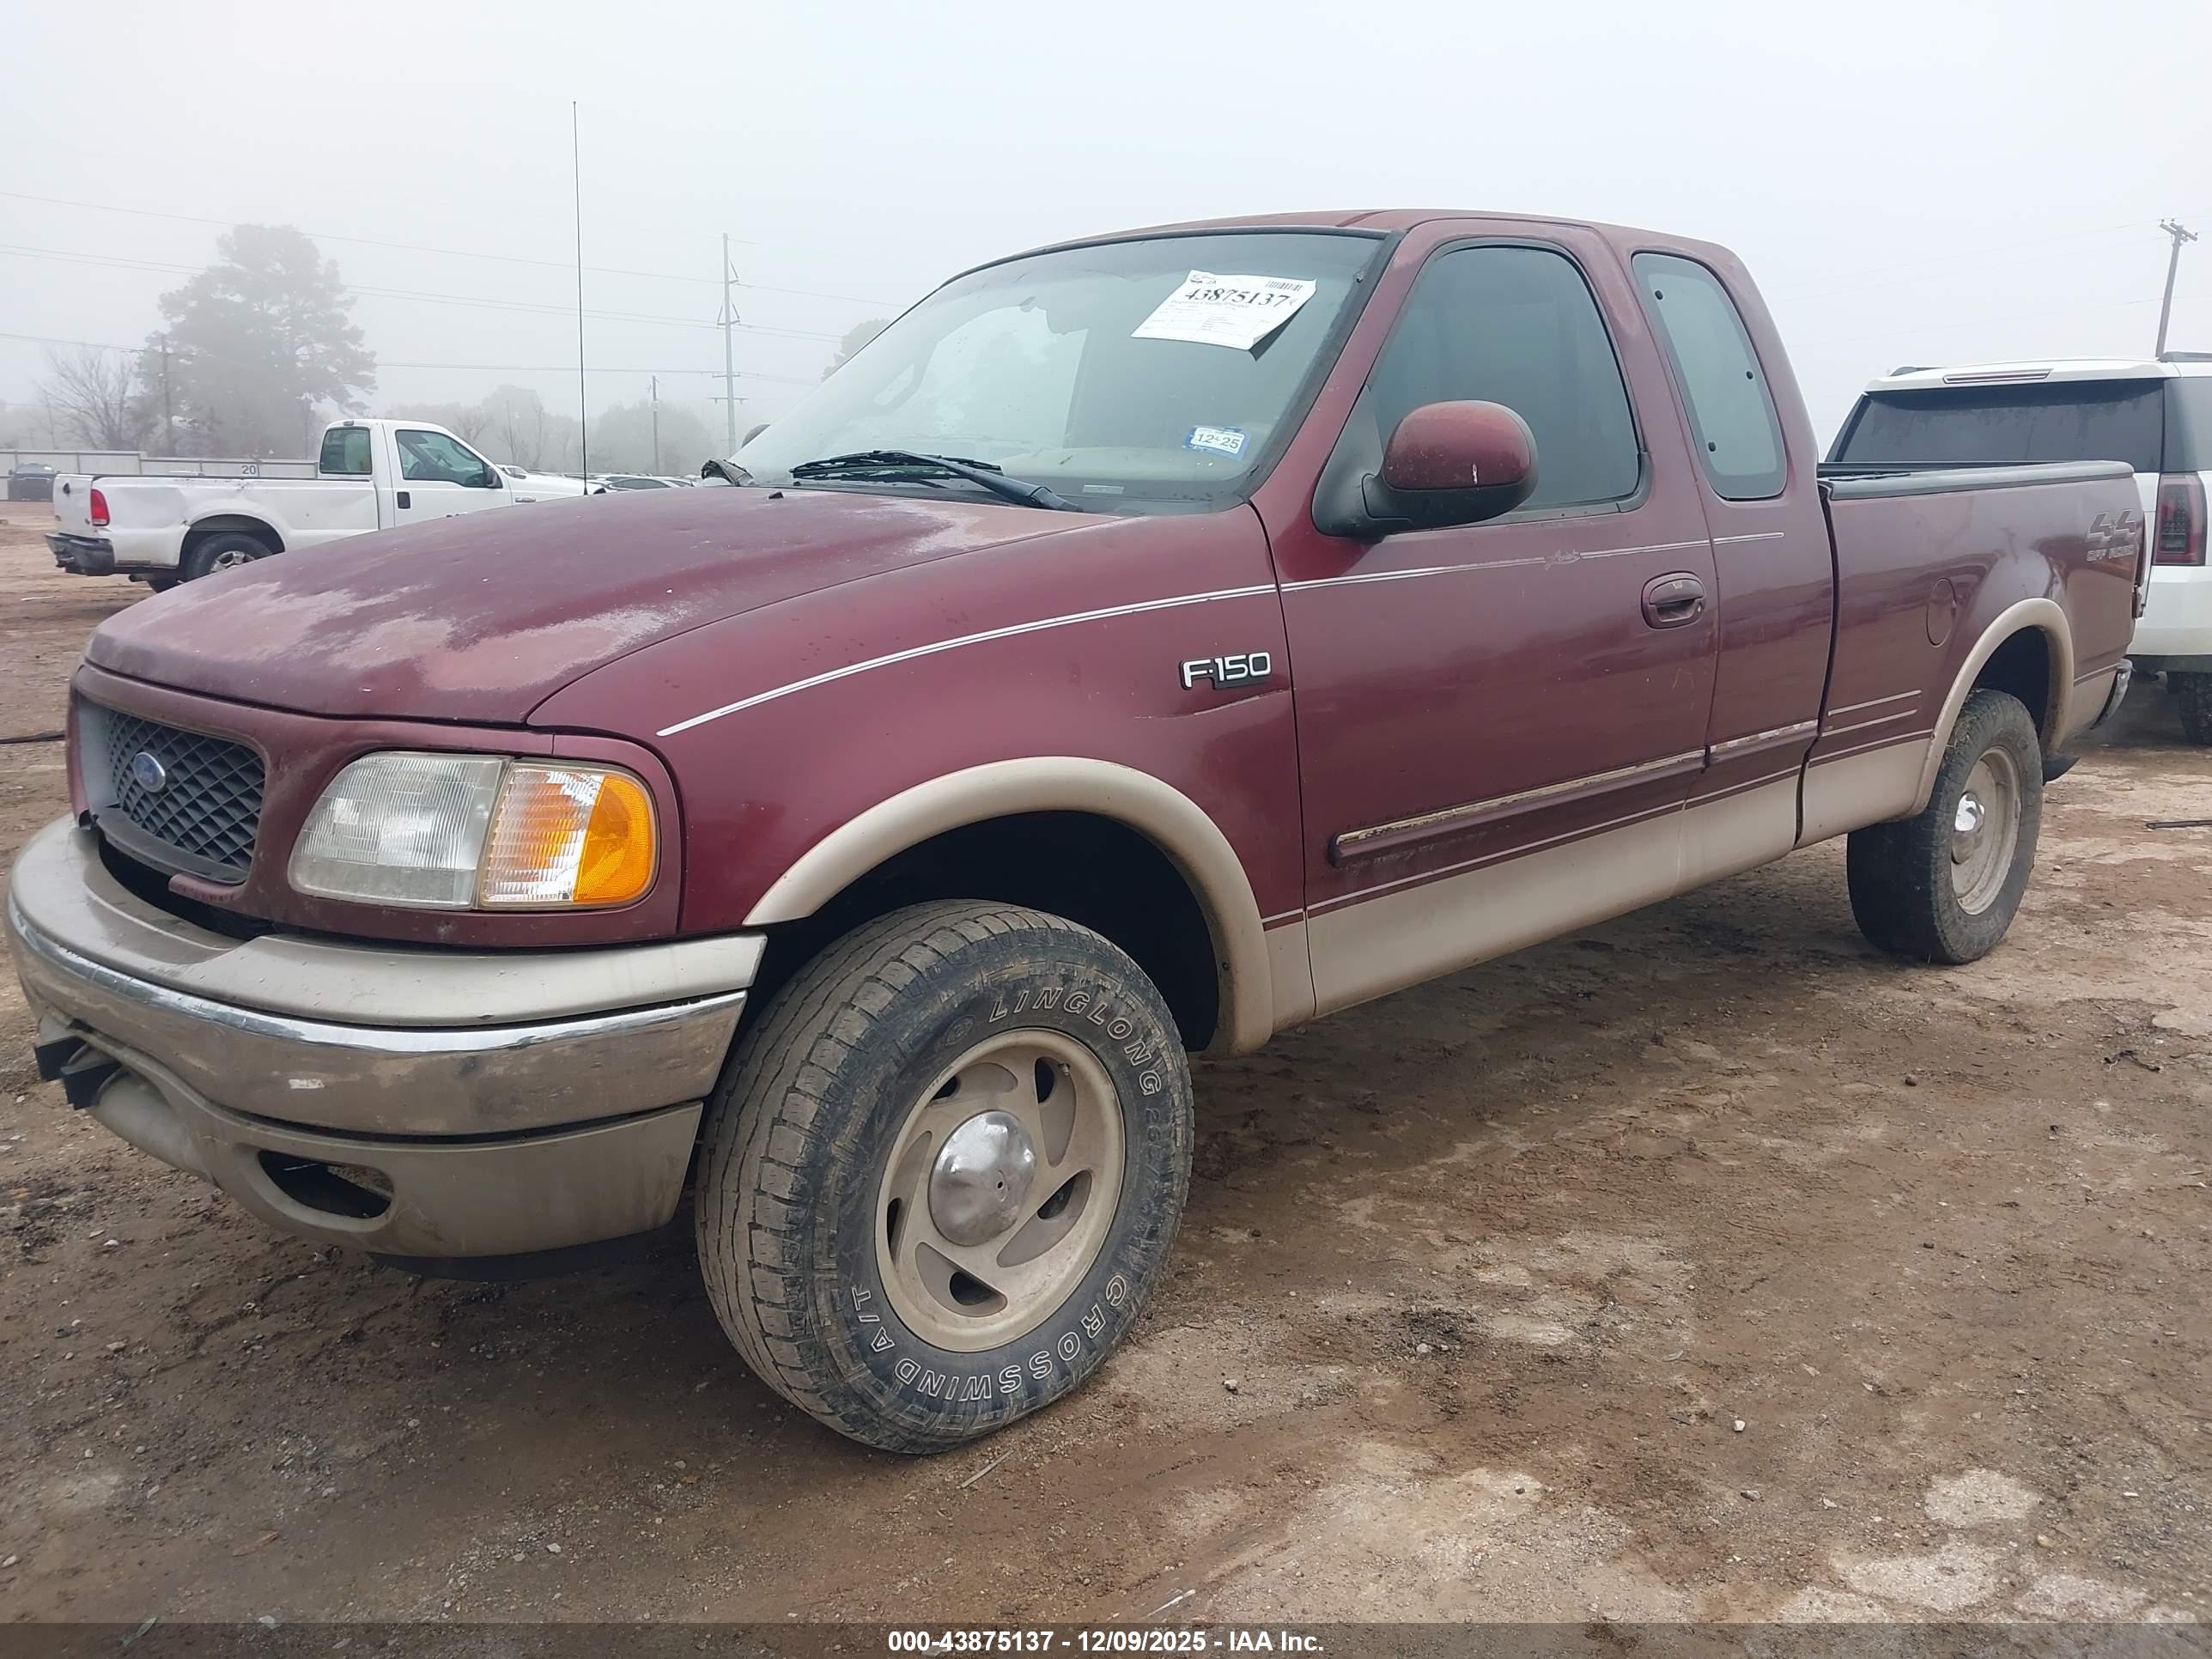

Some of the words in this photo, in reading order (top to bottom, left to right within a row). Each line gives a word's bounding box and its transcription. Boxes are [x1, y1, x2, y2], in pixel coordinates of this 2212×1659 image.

[1184, 288, 1291, 307] 43875137
[241, 465, 257, 475] 20
[988, 987, 1162, 1097] LINGLONG
[852, 1285, 895, 1352] A/T
[895, 1275, 1127, 1401] CROSSWIND
